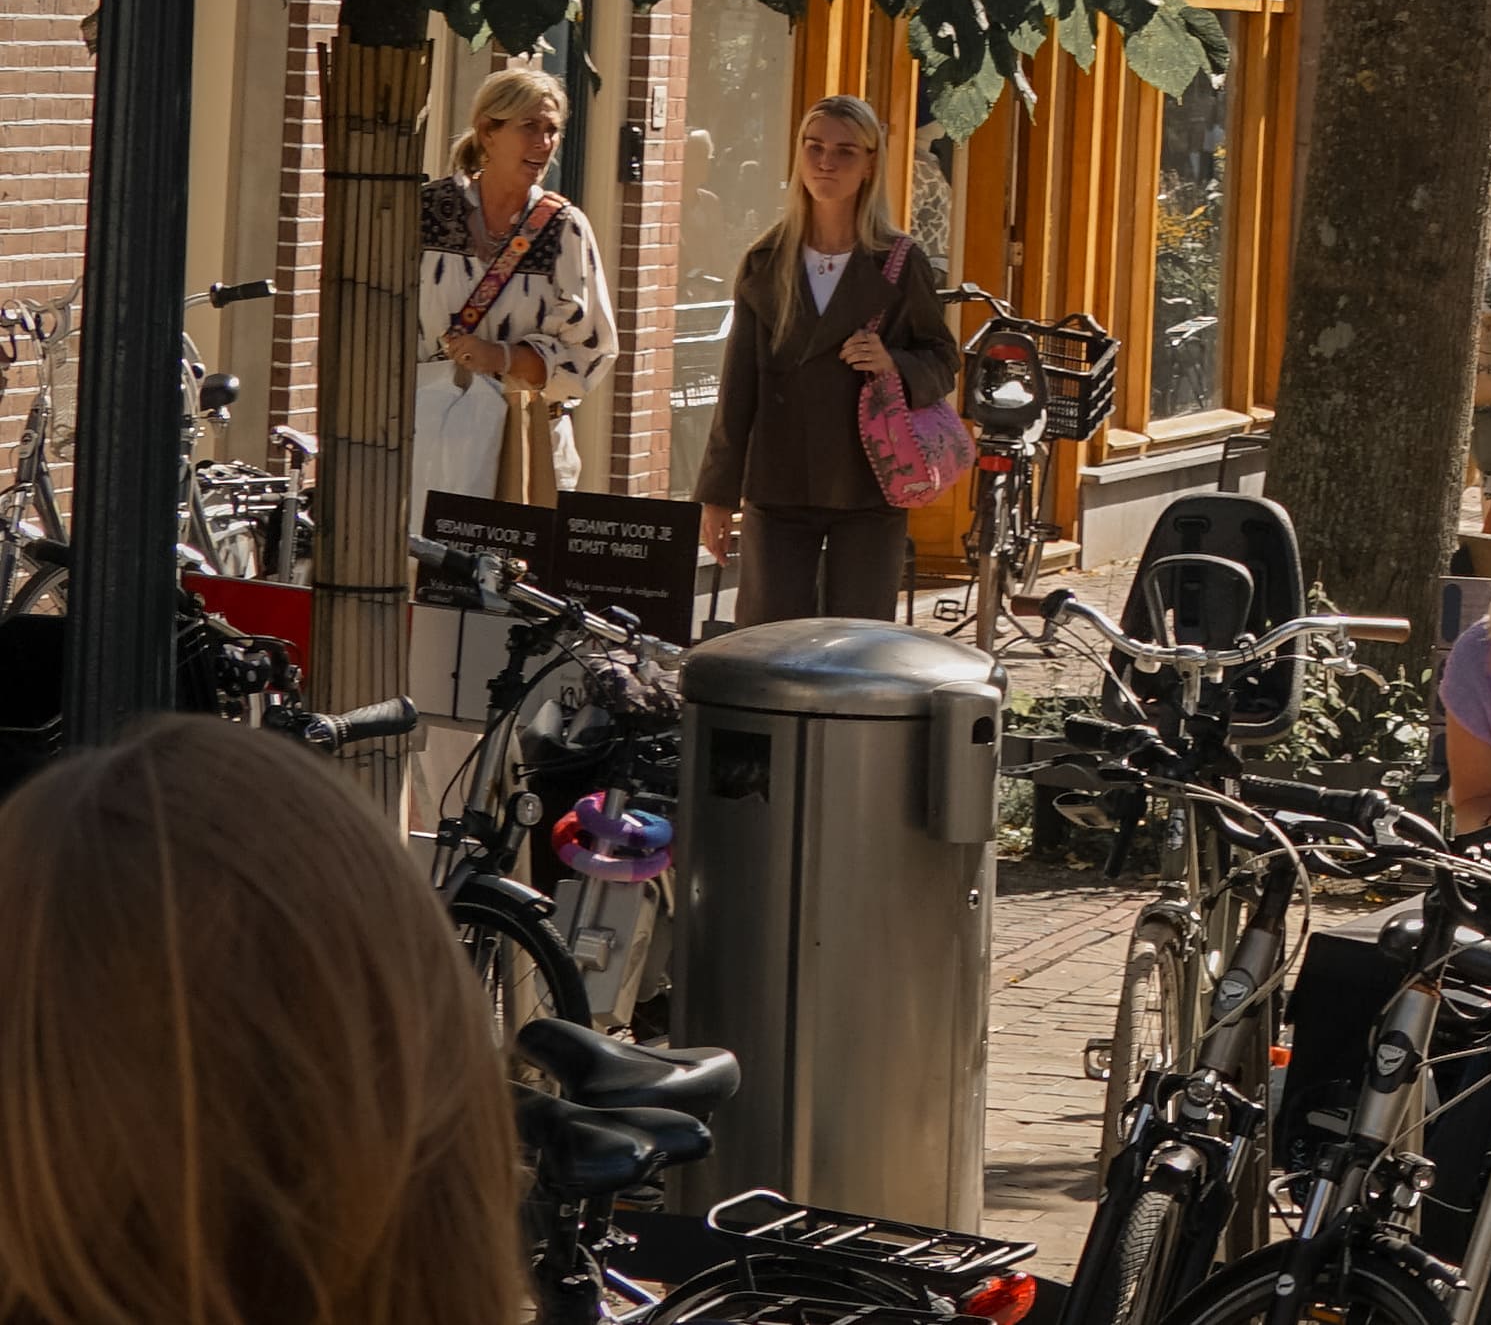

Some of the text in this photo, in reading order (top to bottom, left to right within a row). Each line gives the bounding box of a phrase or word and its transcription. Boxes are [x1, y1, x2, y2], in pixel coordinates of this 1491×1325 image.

[485, 525, 521, 544] VOOR
[521, 531, 537, 547] JE
[567, 517, 673, 542] BEDANKT VOOR JE
